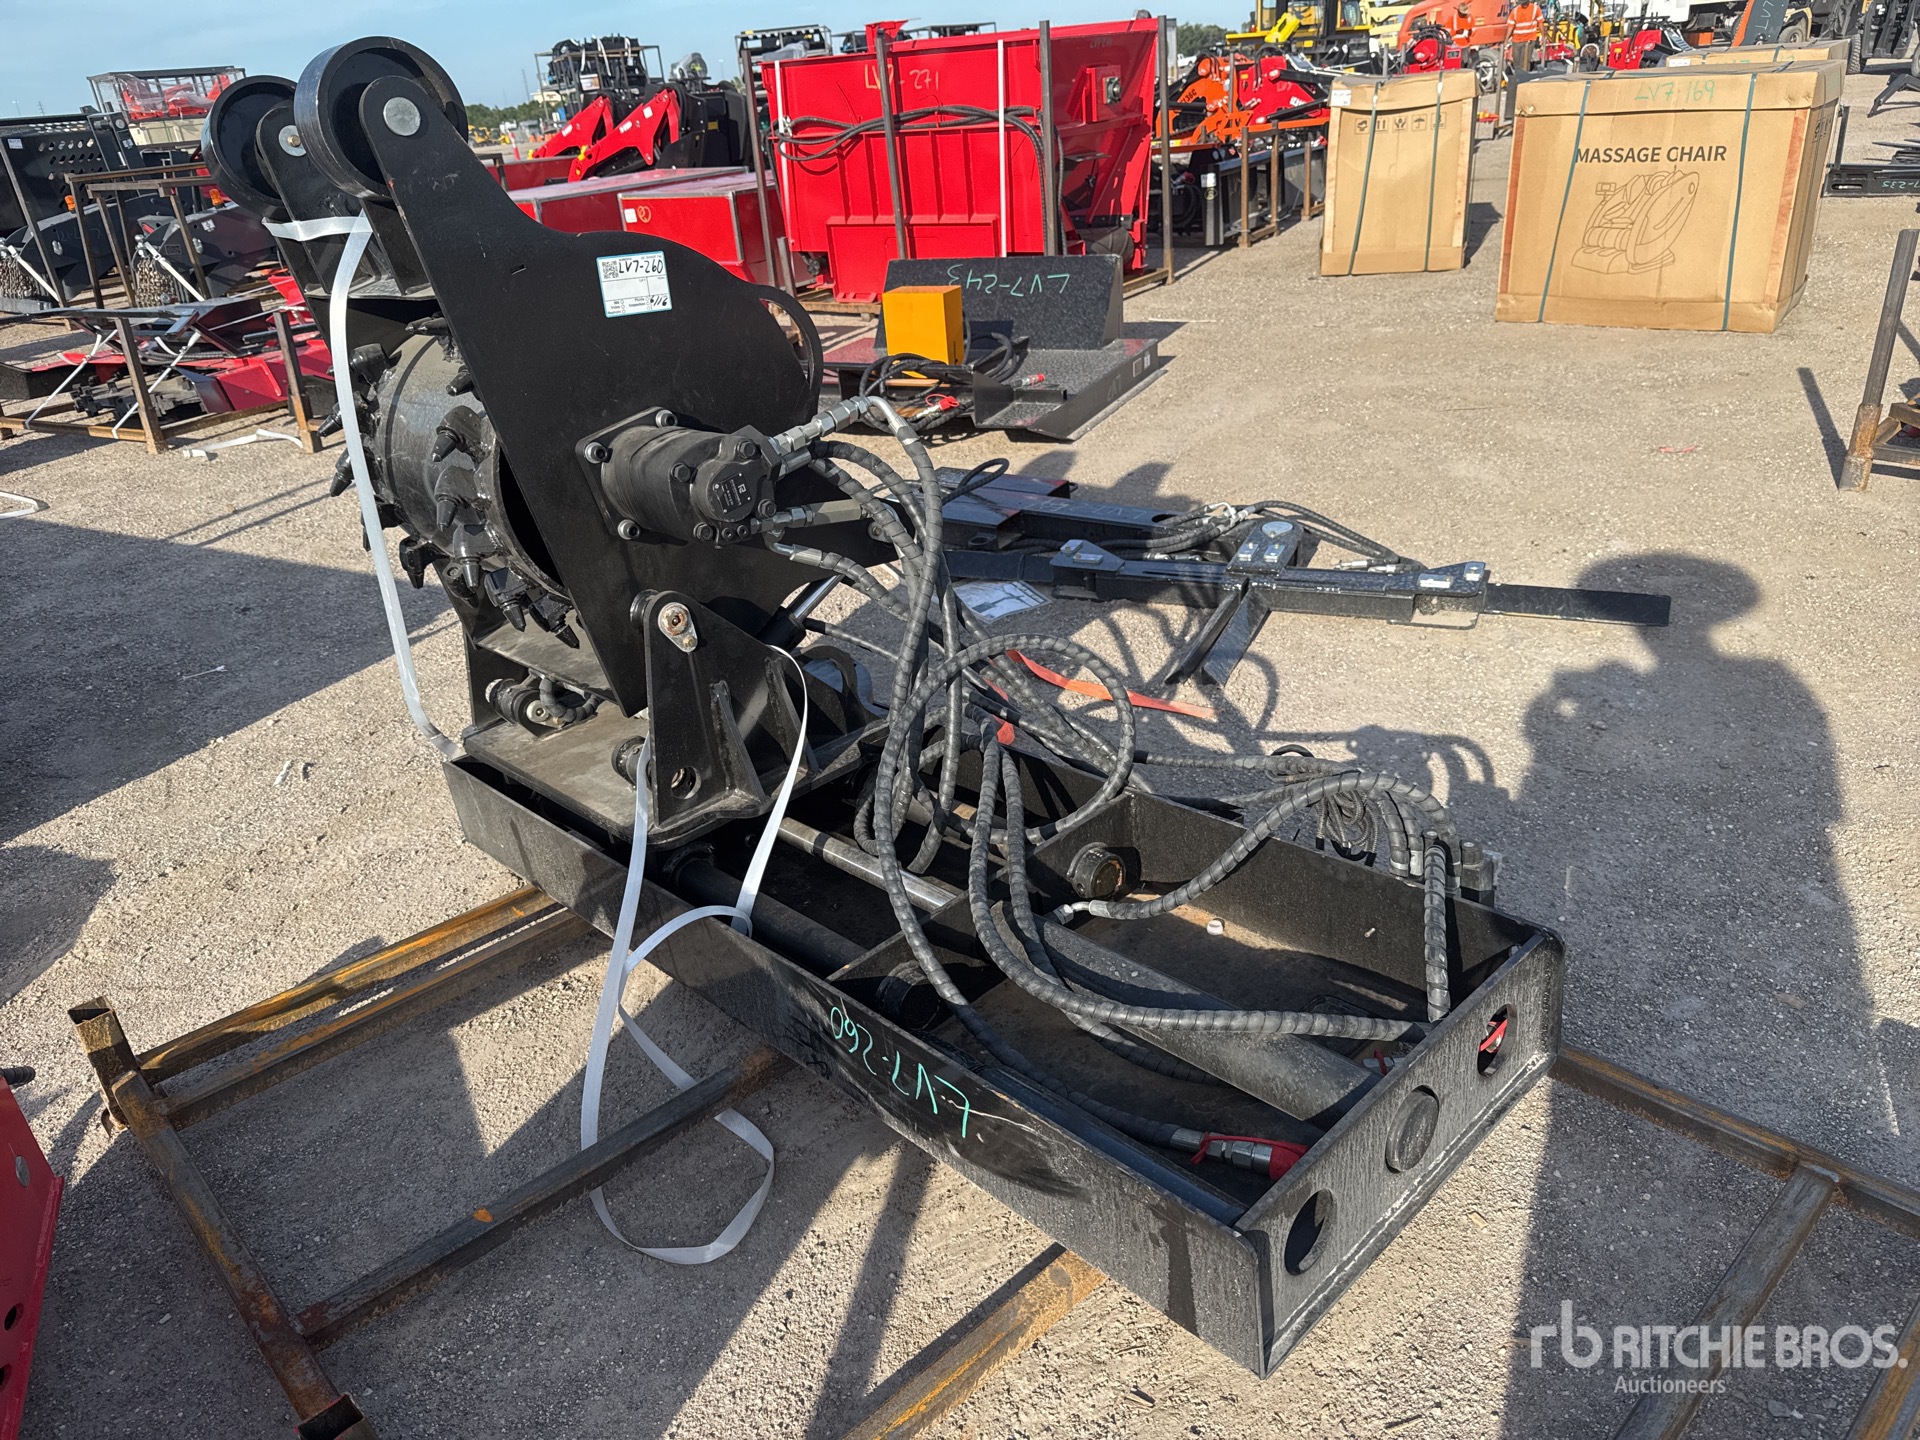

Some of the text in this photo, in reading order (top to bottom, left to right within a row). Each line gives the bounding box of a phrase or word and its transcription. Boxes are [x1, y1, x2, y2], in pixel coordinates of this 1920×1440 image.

[1575, 146, 1727, 163] MASSAGE CHAIR
[618, 258, 664, 274] LV7-260
[946, 263, 1071, 297] LV7-243
